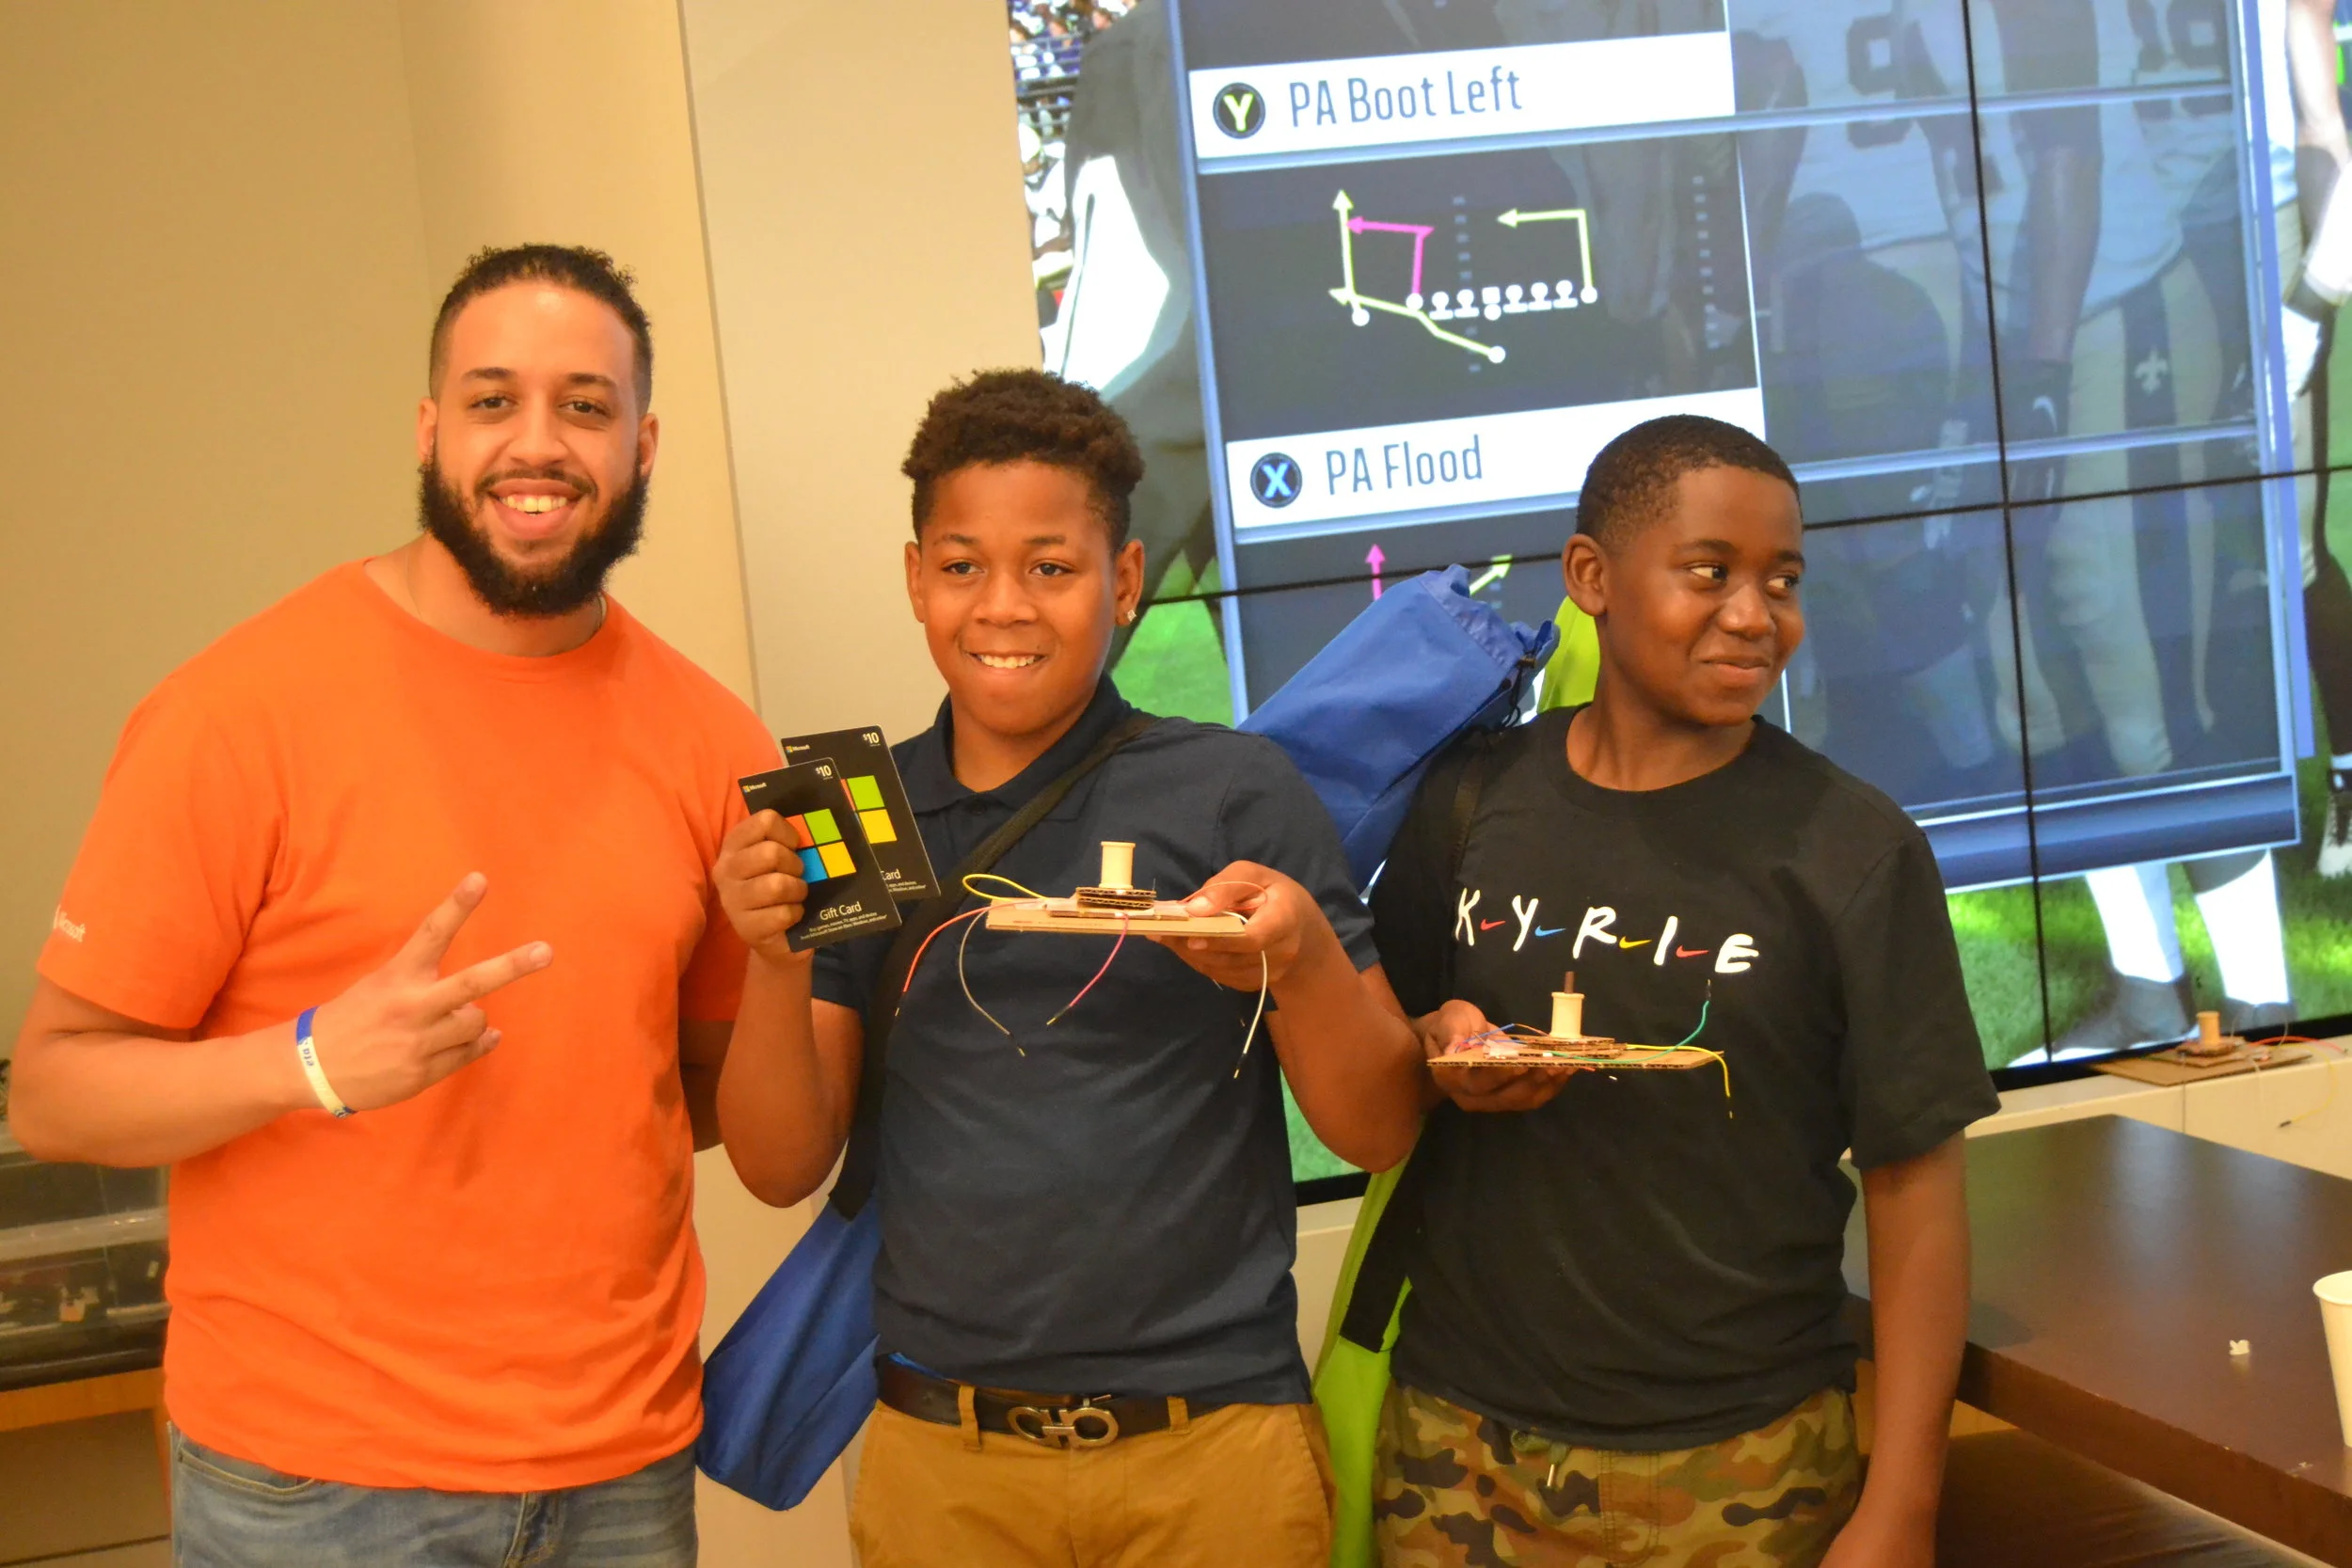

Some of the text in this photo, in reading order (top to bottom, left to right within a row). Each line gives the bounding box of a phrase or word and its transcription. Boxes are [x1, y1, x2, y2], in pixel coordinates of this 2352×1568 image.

[1223, 65, 1522, 133] Y PA Boot Left
[1262, 434, 1483, 499] X PA Flood
[863, 732, 880, 745] $10
[815, 765, 833, 778] $10
[819, 901, 862, 921] Gift Card
[1454, 887, 1759, 974] KYRIE
